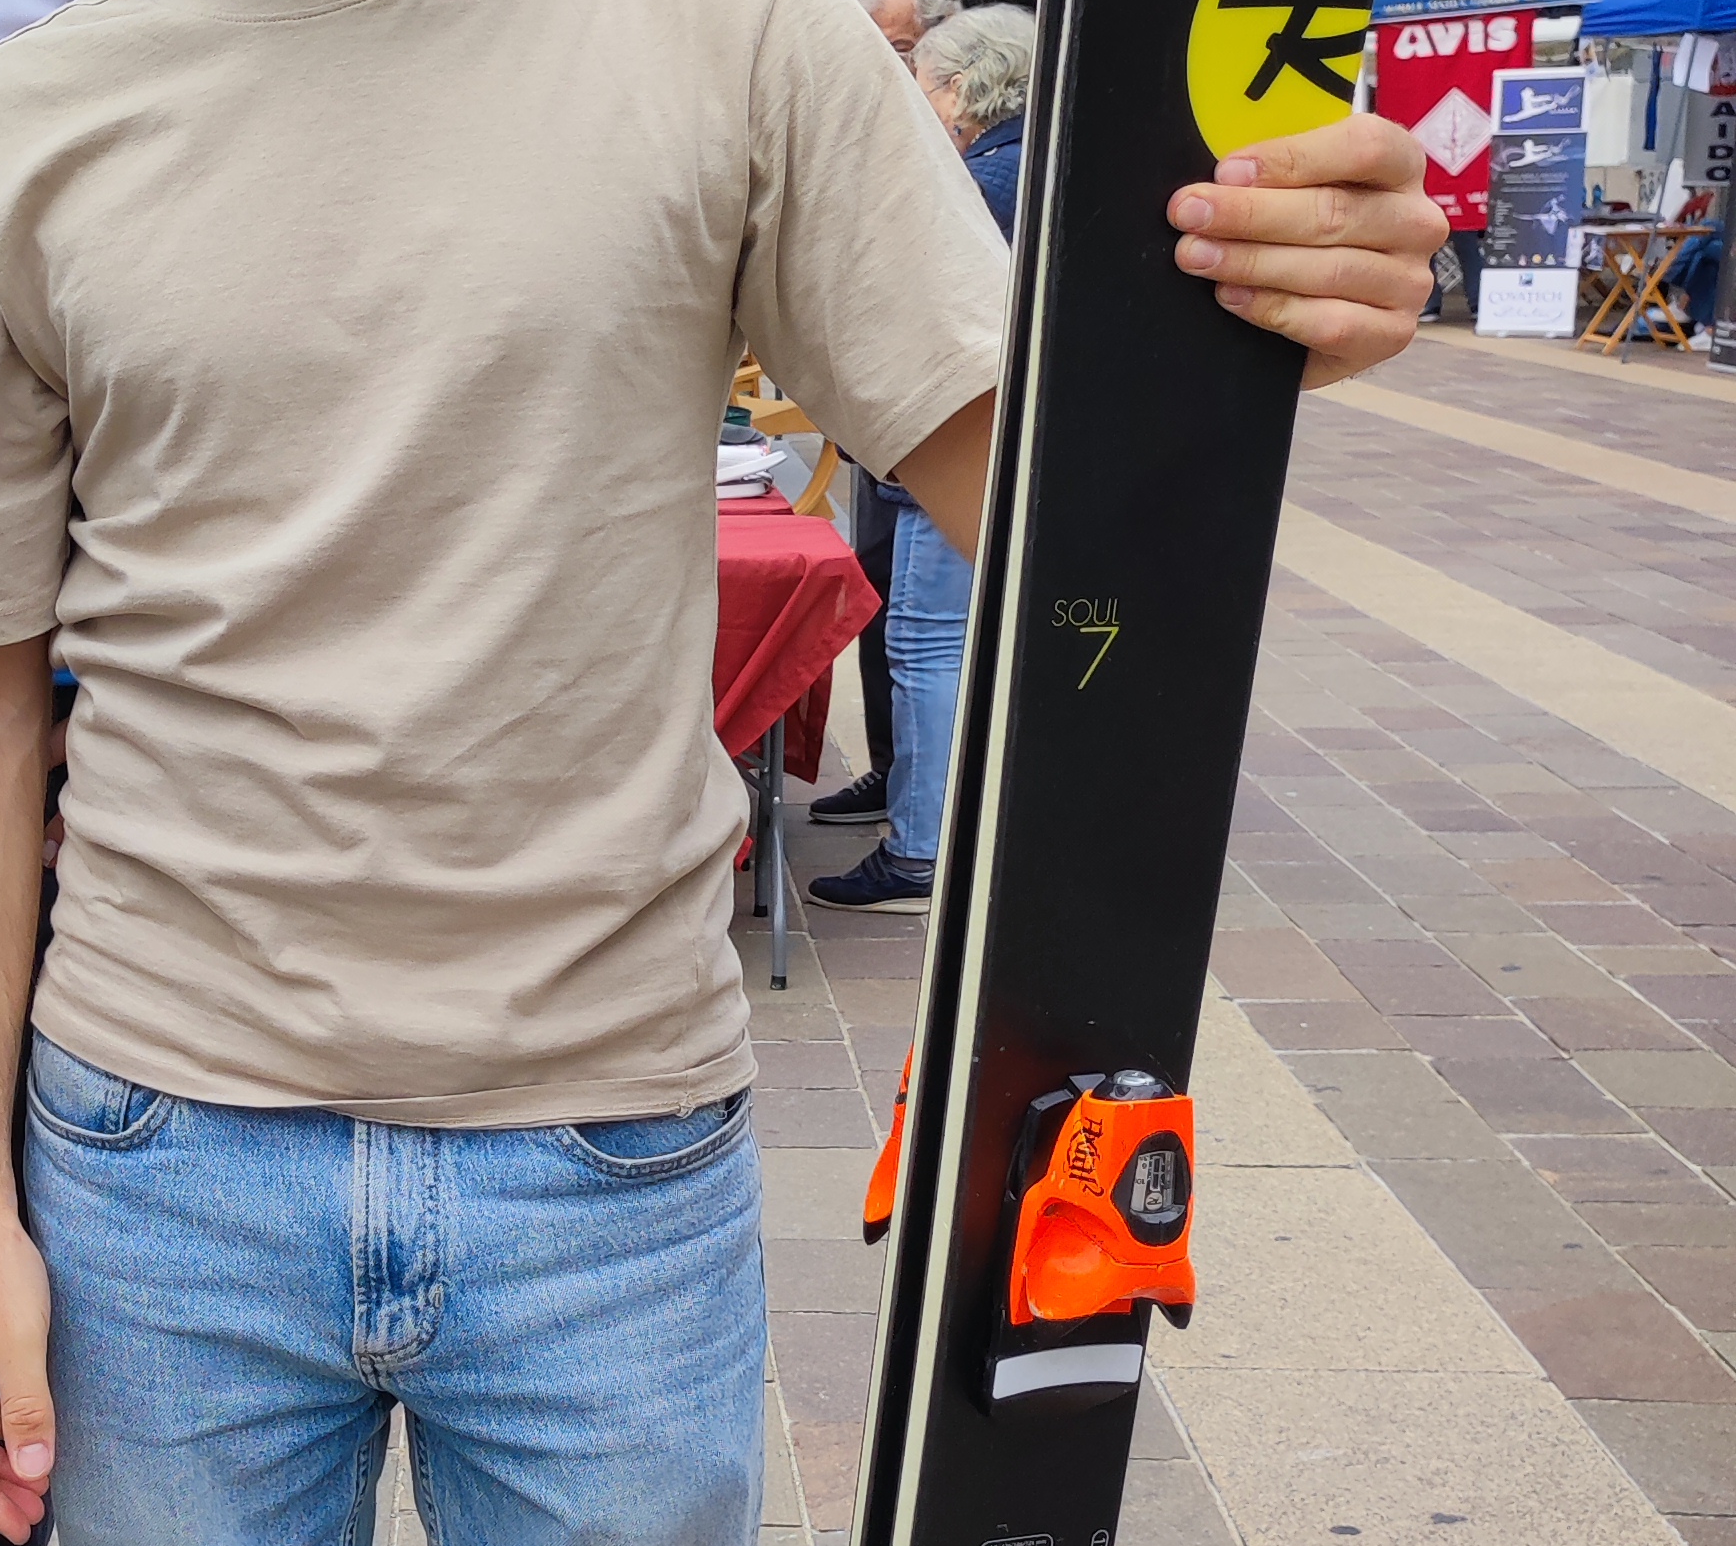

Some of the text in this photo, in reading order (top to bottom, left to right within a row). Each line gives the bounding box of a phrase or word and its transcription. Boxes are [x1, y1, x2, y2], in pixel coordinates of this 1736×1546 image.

[1392, 16, 1519, 60] AVIS
[1051, 597, 1121, 627] SOUL
[1077, 626, 1120, 691] 7
